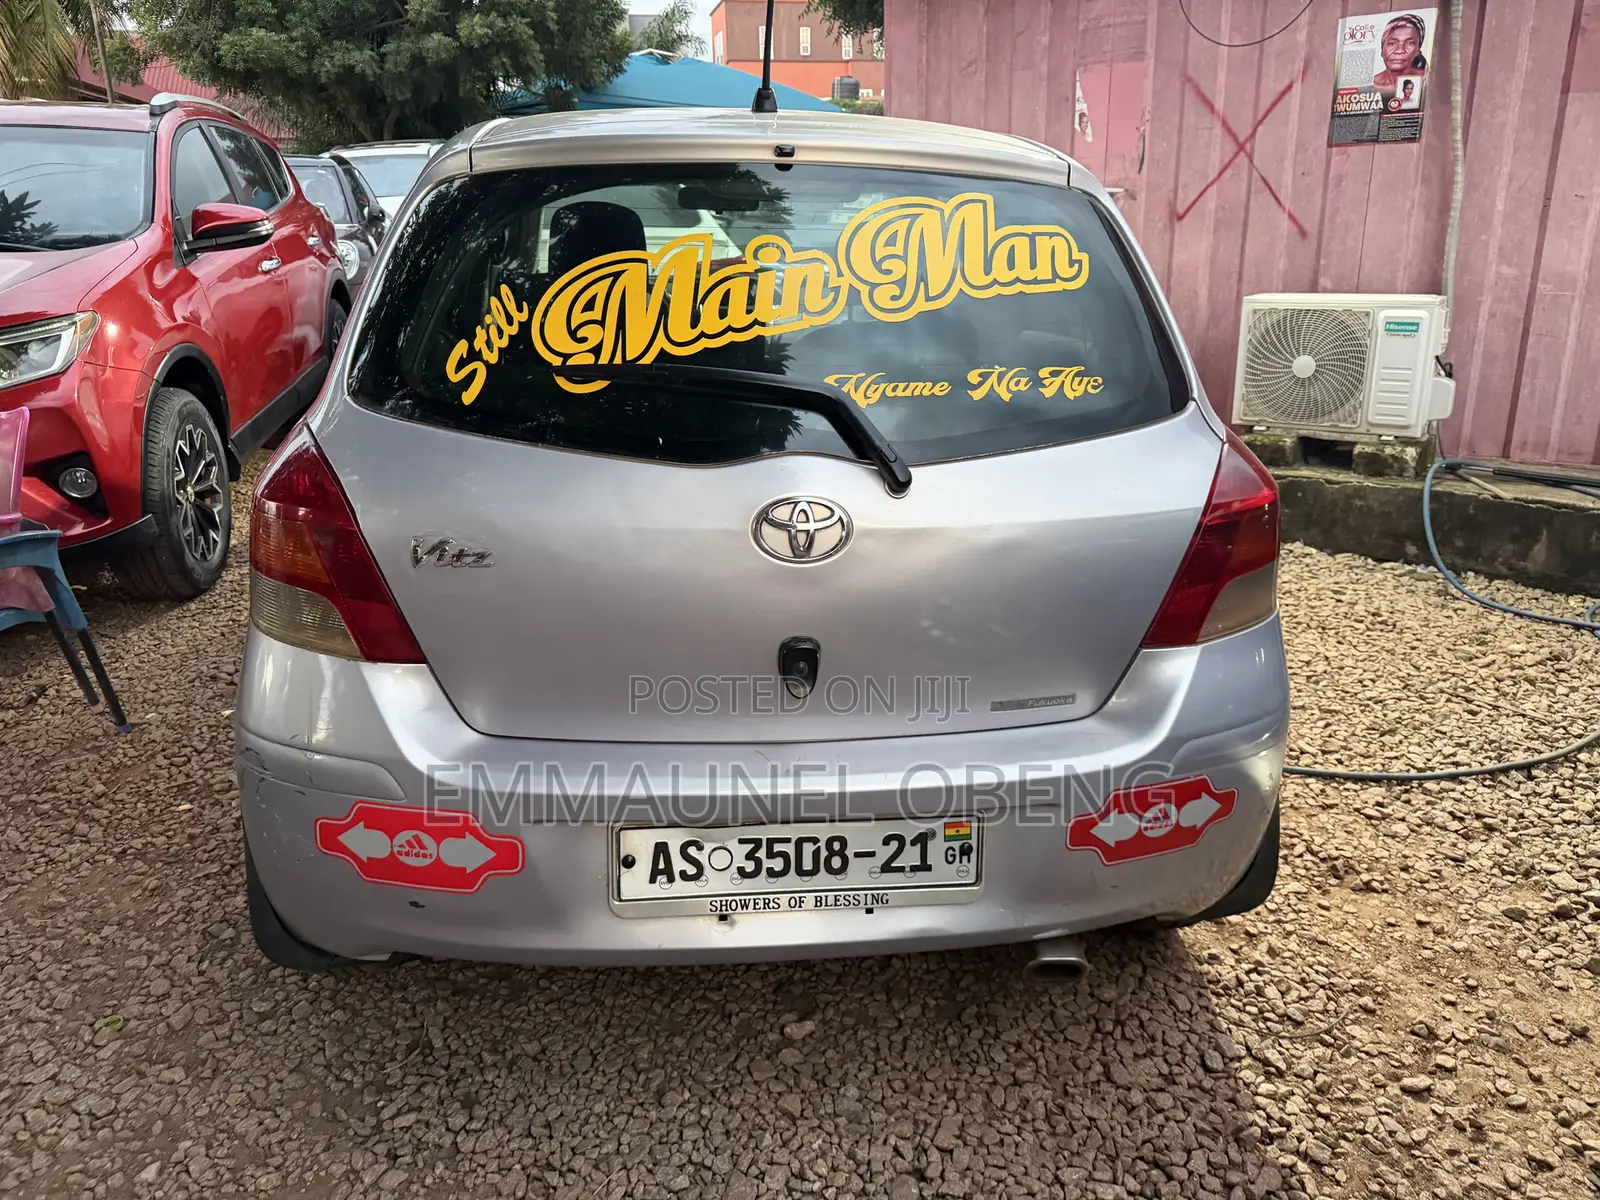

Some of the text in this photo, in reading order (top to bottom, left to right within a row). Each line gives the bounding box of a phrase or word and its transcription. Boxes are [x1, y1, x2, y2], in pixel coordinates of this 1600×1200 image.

[1336, 92, 1382, 104] AKOSUA
[446, 192, 1089, 405] Still Main Man
[824, 372, 951, 408] Nyame
[967, 367, 1032, 403] Na
[411, 537, 495, 568] Vitz
[1027, 697, 1073, 707] Fukuoka
[396, 850, 434, 860] adidas
[648, 831, 933, 885] AS 3508-21
[709, 893, 890, 913] SHOWERS OF BLESSING
